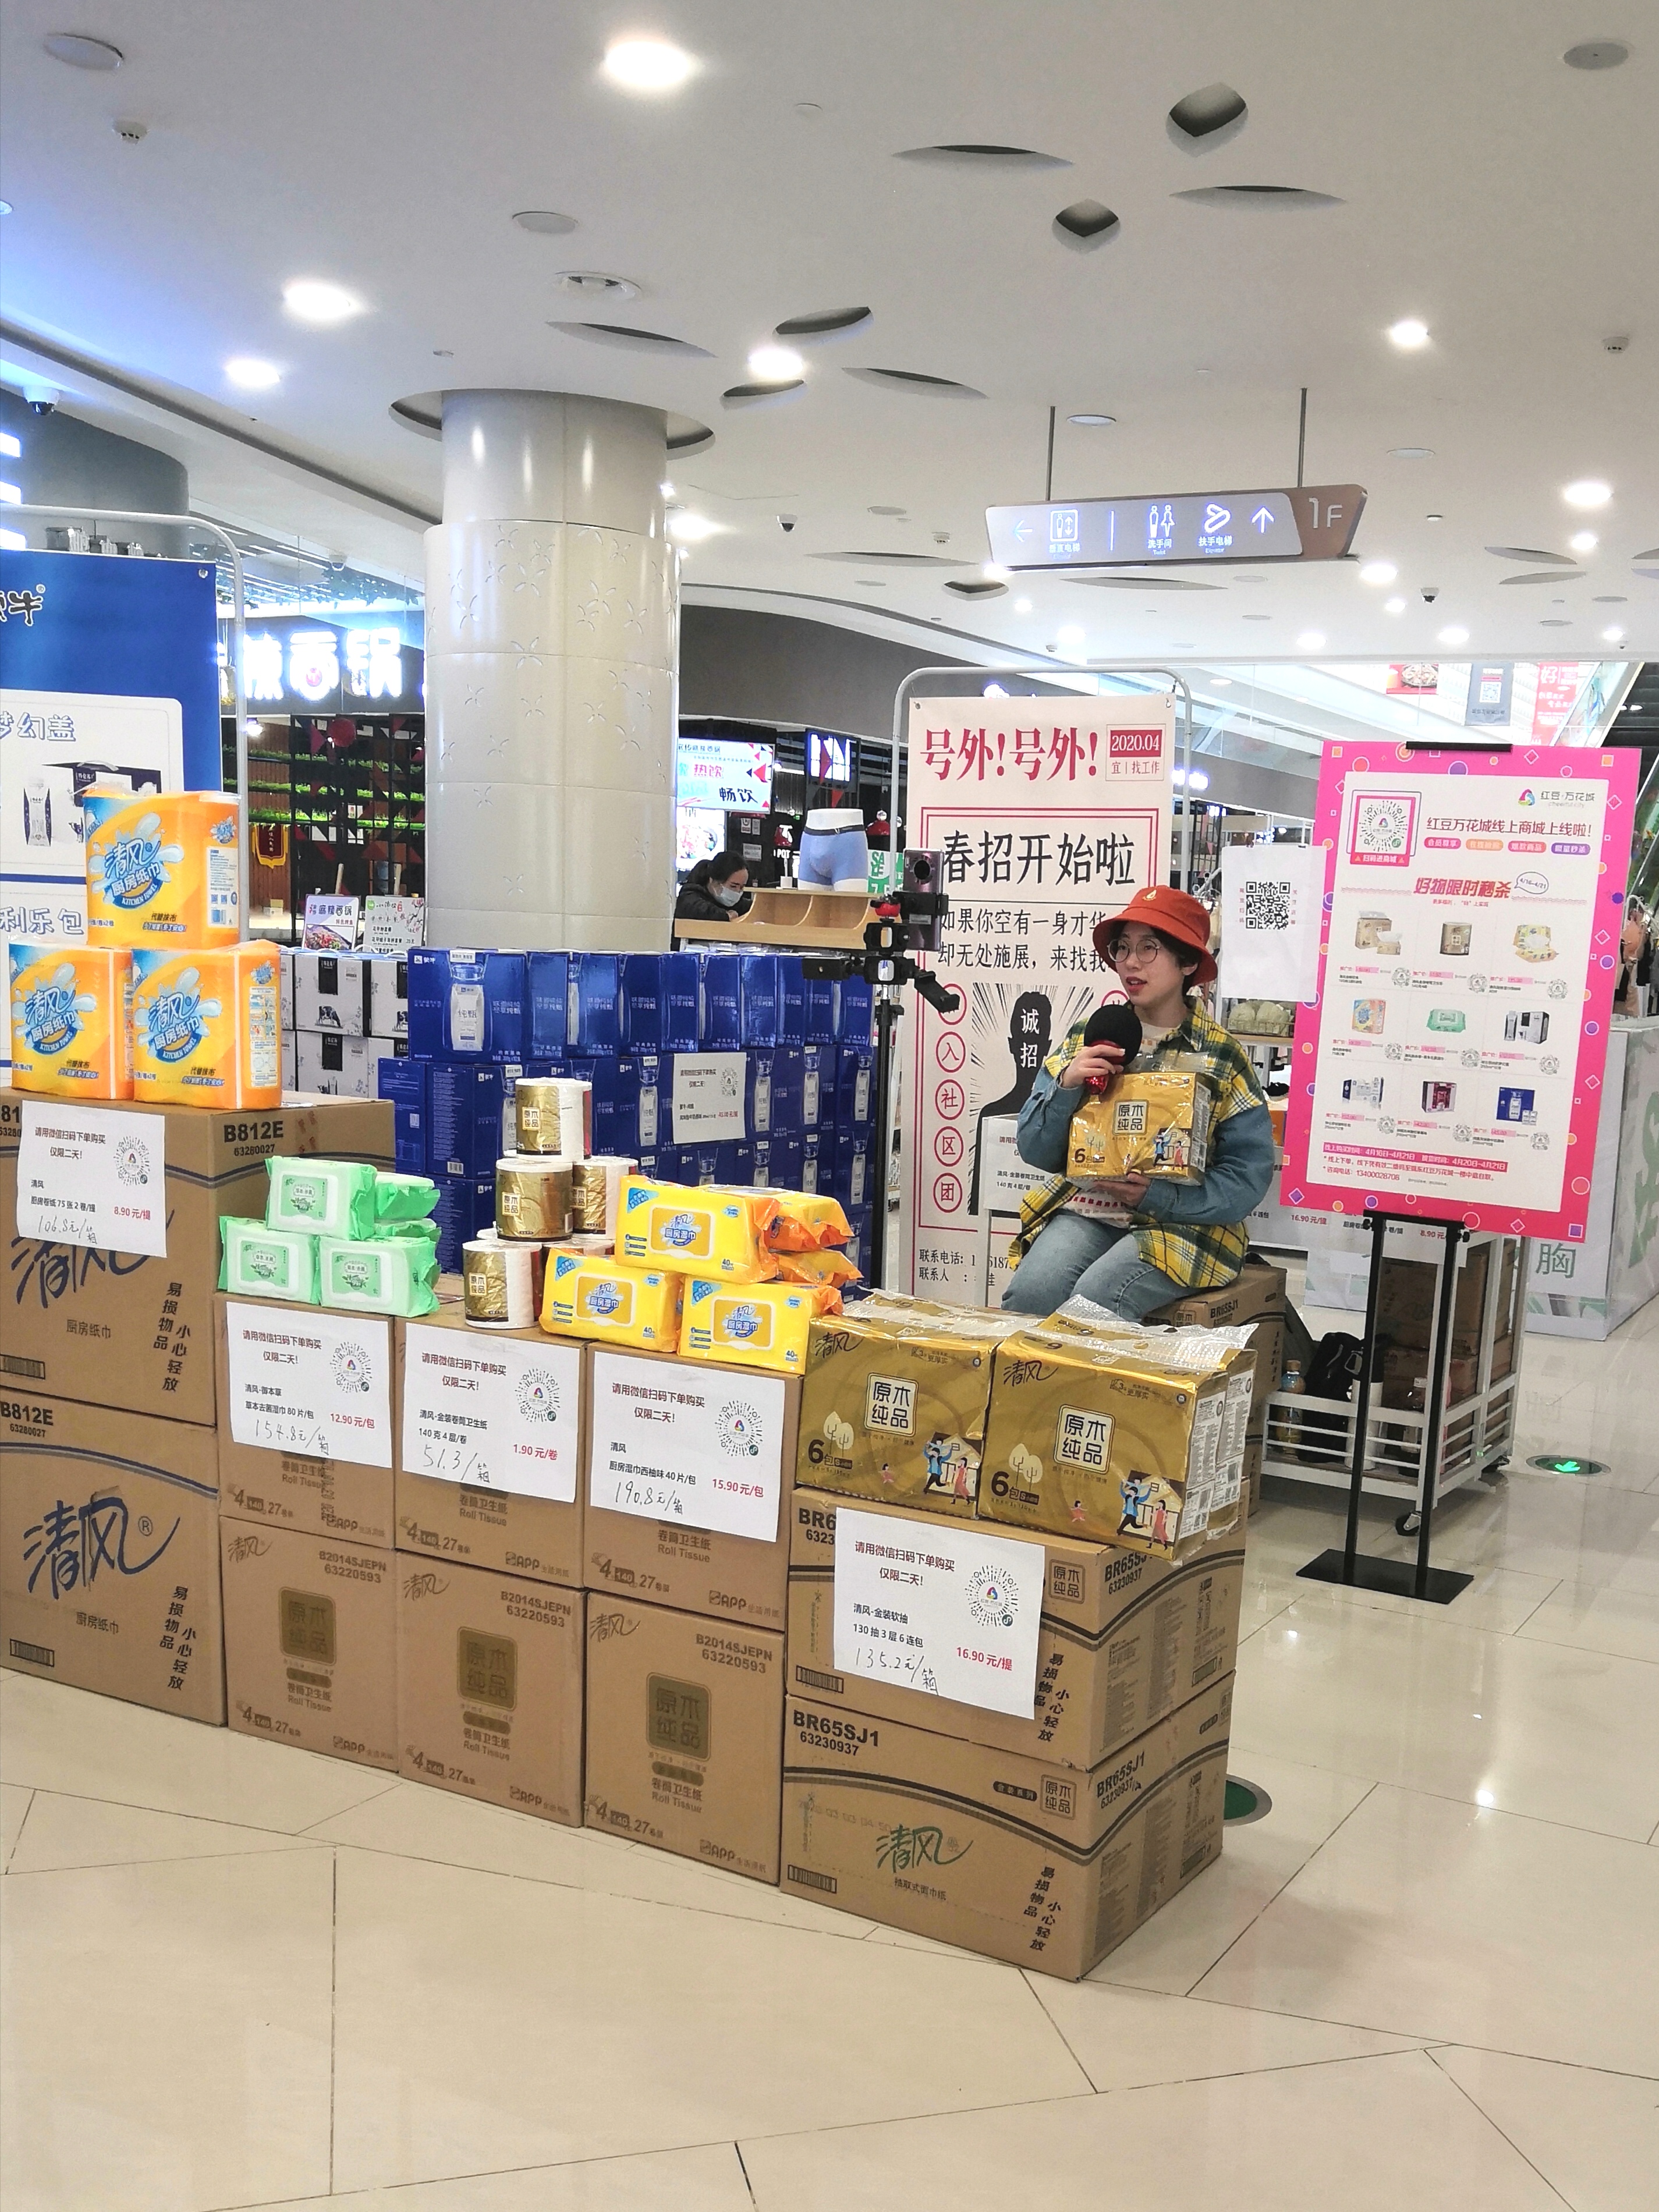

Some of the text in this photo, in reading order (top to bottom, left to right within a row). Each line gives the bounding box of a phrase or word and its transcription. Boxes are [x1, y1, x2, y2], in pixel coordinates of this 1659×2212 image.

[1308, 497, 1342, 529] 1F
[1147, 538, 1172, 549] 洗手间
[1198, 536, 1233, 547] 扶手电梯
[1111, 733, 1160, 751] 2020.04
[719, 787, 758, 803] 畅饮
[105, 838, 161, 878] 清风
[944, 830, 1136, 887] 春招开始啦
[110, 863, 161, 896] 厨房纸巾
[25, 986, 76, 1024] 清风
[148, 994, 201, 1031] 清风
[31, 1012, 75, 1043] 厨房纸巾
[154, 1016, 200, 1050] 厨房纸巾
[1020, 1009, 1040, 1068] 诚招
[1118, 1104, 1144, 1116] 原木
[35, 1126, 106, 1144] 请用微信扫码下单购买
[224, 1121, 283, 1143] B812E
[1118, 1118, 1143, 1130] 纯品
[31, 1180, 44, 1189] 清风
[58, 1200, 65, 1208] 75
[66, 1201, 73, 1210] 张
[114, 1207, 130, 1217] 8.90
[132, 1208, 151, 1220] 元/提
[1291, 1214, 1310, 1222] 16.90
[665, 1227, 696, 1241] 厨房湿巾
[1420, 1229, 1436, 1238] 8.90
[1536, 1242, 1577, 1279] 胸
[590, 1296, 619, 1309] 厨房湿巾
[153, 1282, 182, 1350] 易损物品
[727, 1319, 758, 1332] 厨房湿巾
[67, 1319, 111, 1339] 厨房纸巾
[243, 1330, 322, 1350] 请用微信扫码下单购买
[162, 1324, 191, 1392] 小心轻放
[816, 1332, 864, 1359] 清风
[422, 1353, 506, 1376] 请用微信扫码下单购买
[1002, 1360, 1059, 1388] 清风
[612, 1383, 706, 1408] 请用微信扫码下单购买
[873, 1381, 911, 1408] 原木
[1, 1402, 54, 1426] B812E
[288, 1408, 296, 1416] 80
[330, 1413, 352, 1425] 12.90
[354, 1416, 375, 1429] 元/包
[871, 1403, 909, 1429] 纯品
[10, 1424, 46, 1438] 63280027
[1064, 1413, 1107, 1442] 原木
[419, 1428, 433, 1438] 140
[433, 1431, 441, 1440] 克
[442, 1433, 447, 1441] 4
[513, 1444, 533, 1456] 1.90
[611, 1442, 626, 1454] 清风
[1062, 1438, 1103, 1466] 纯品
[609, 1461, 764, 1498] 厨房湿巾西柚味 40 片/包 15.90 元/包
[460, 1509, 507, 1526] Roll Tissue
[23, 1497, 180, 1600] 清风
[228, 1536, 272, 1564] 清风
[319, 1550, 387, 1572] B2014SJEPN
[658, 1544, 710, 1563] Roll Tissue
[855, 1541, 955, 1572] 请用微信扫码下单购买
[324, 1564, 381, 1583] 63220593
[1054, 1565, 1080, 1582] 原木
[402, 1573, 450, 1601] 清风
[1054, 1581, 1080, 1598] 纯品
[501, 1590, 572, 1617] B2014SJEPN
[721, 1593, 747, 1610] APP
[76, 1611, 119, 1635] 厨房纸巾
[159, 1586, 188, 1649] 易损物品
[506, 1605, 565, 1628] 63220593
[590, 1614, 640, 1642] 清风
[168, 1628, 196, 1690] 小心轻放
[696, 1633, 773, 1661] B2014SJEPN
[853, 1623, 1013, 1671] 130 抽 3 层 6 连包 16.90 元/提
[702, 1649, 767, 1674] 63220593
[793, 1710, 880, 1746] BR65SJ1
[1038, 1689, 1069, 1742] 小心轻放
[800, 1731, 859, 1756] 63230937
[1097, 1751, 1145, 1798] BR65SJ1
[1045, 1781, 1071, 1797] 原木
[1045, 1795, 1070, 1814] 纯品
[876, 1824, 973, 1873] 清风
[1023, 1866, 1055, 1918] 易损物品
[1030, 1901, 1061, 1951] 小心轻放
